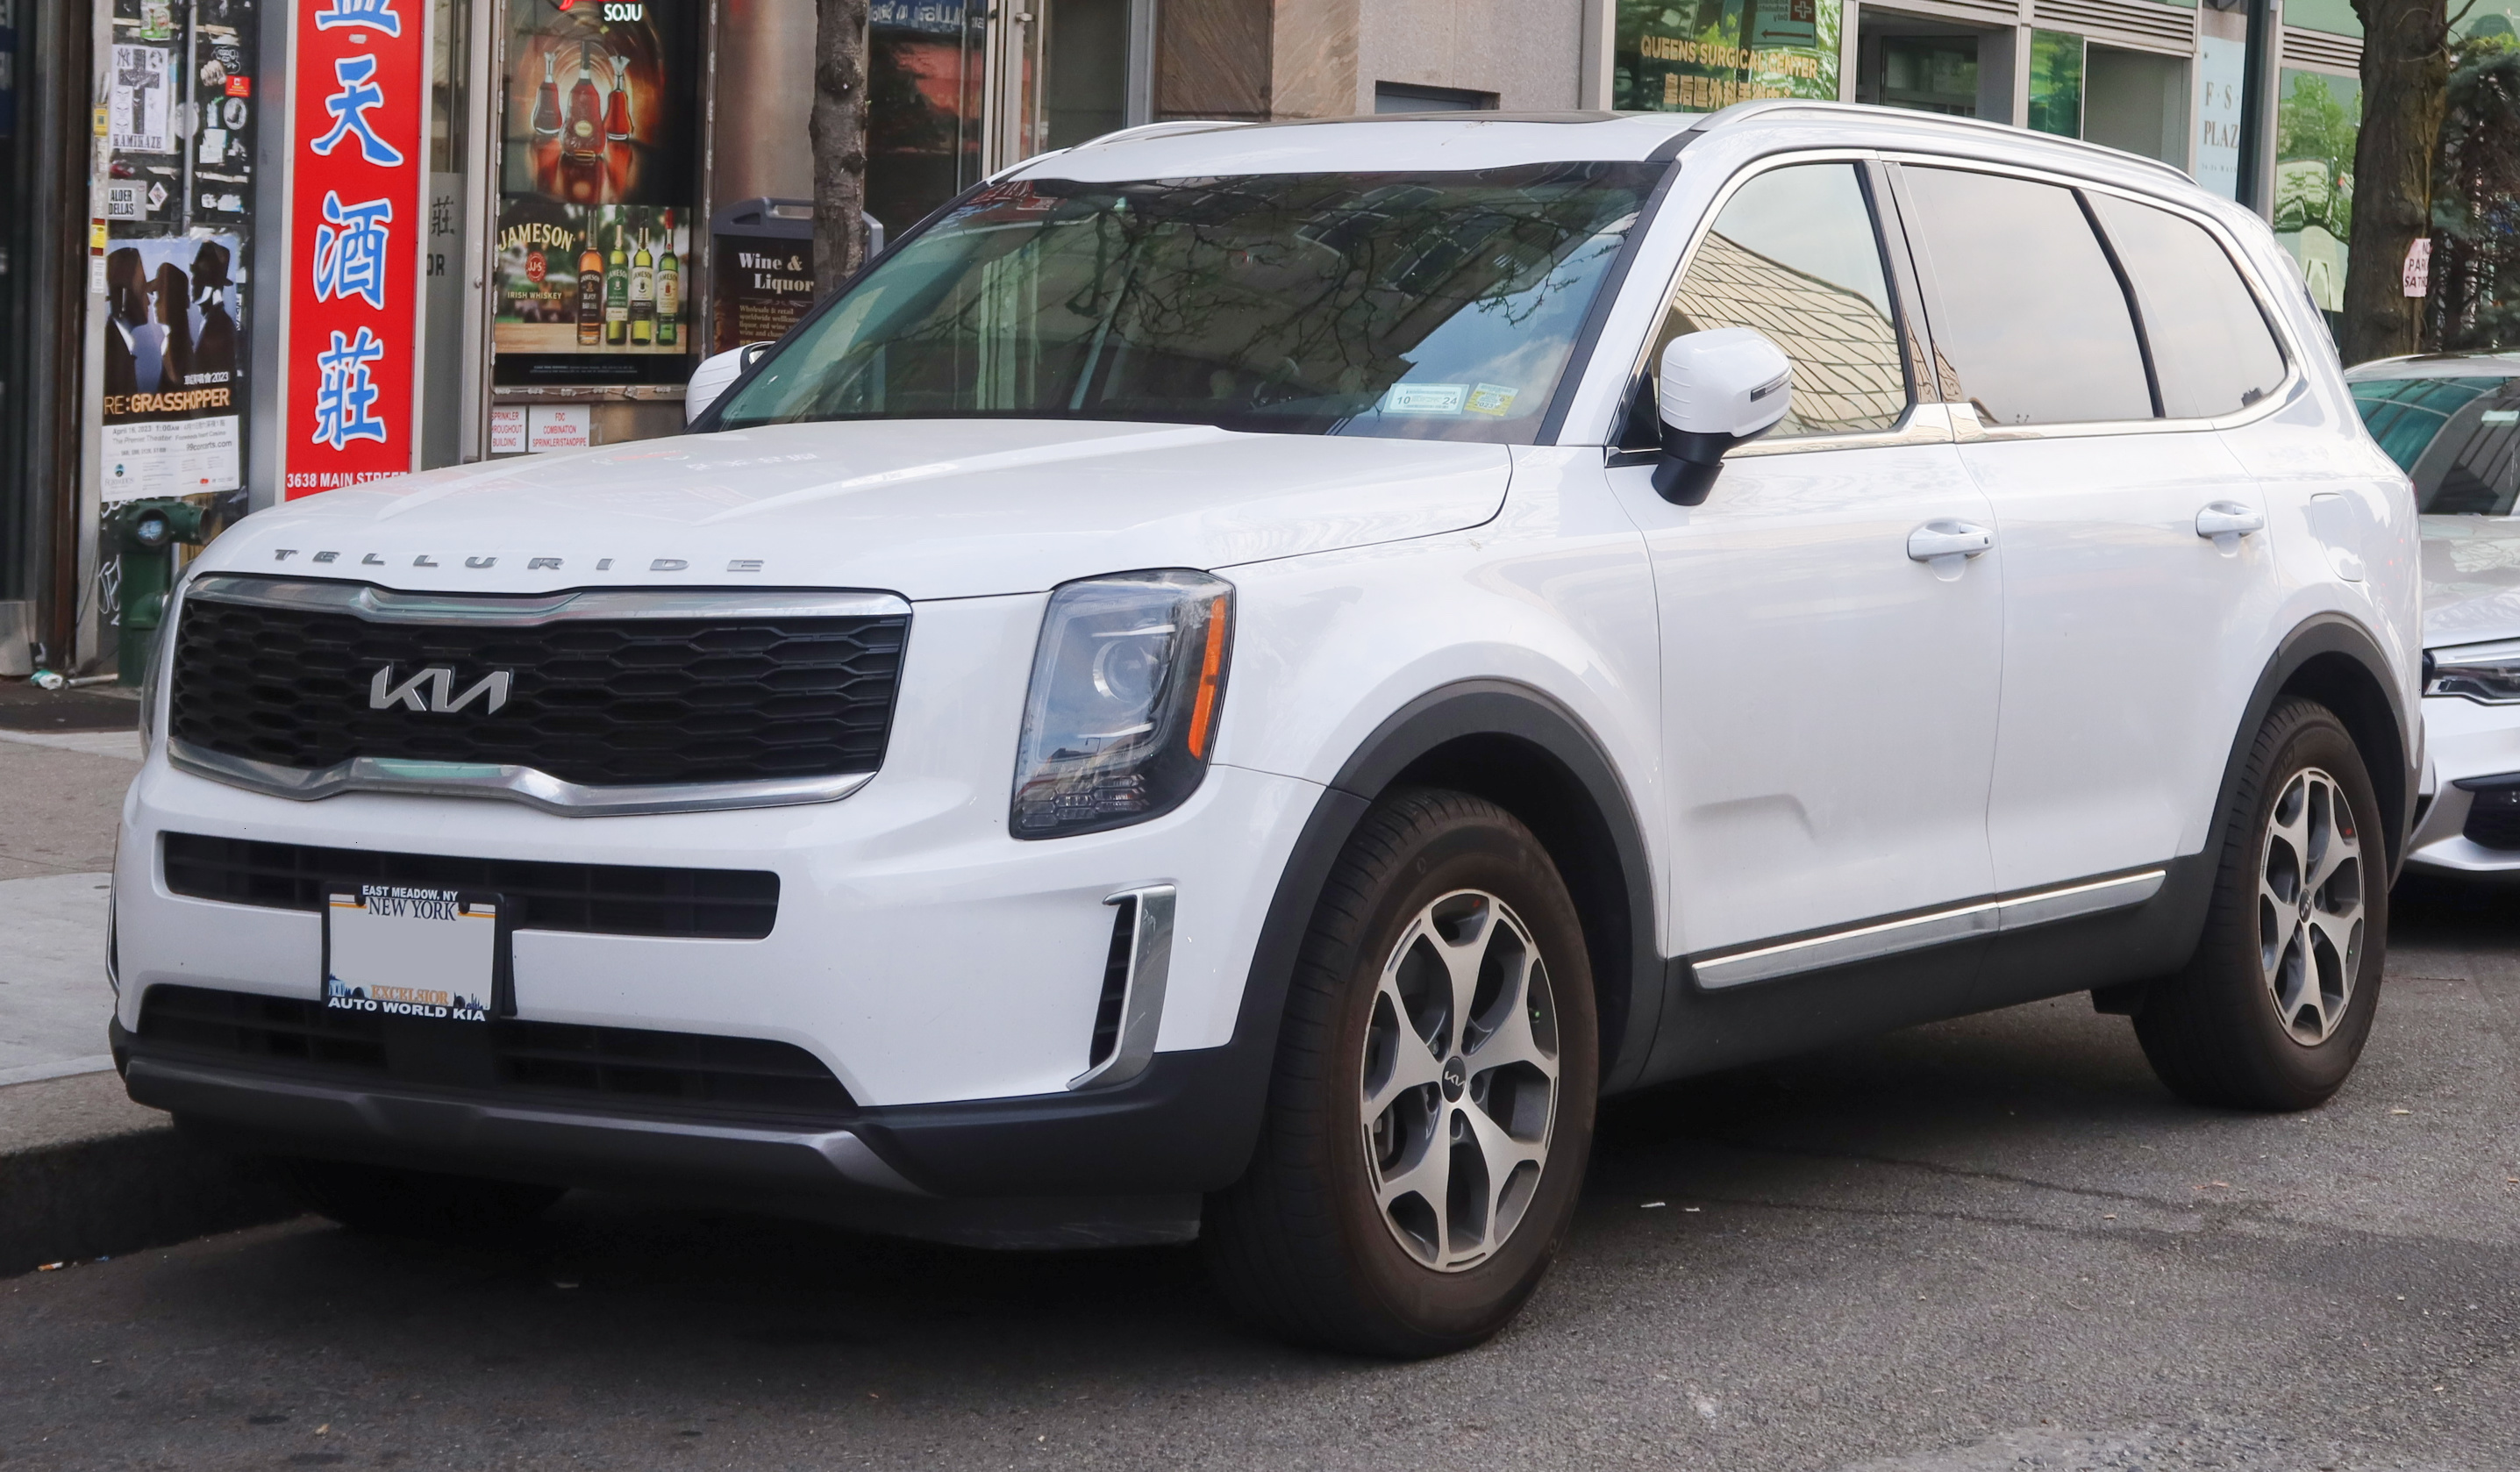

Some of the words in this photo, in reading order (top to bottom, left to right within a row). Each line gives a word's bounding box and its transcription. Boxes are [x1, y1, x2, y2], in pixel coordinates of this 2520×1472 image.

[604, 4, 642, 22] SOJU
[1641, 35, 1696, 63] QUEENS
[1700, 43, 1766, 73] SURGICAL
[1767, 53, 1817, 79] CENTER
[113, 134, 162, 149] KAMIKAZE
[2203, 120, 2239, 149] PLAZ
[497, 223, 574, 253] JAMESON
[739, 253, 782, 270] Wine
[787, 255, 803, 271] &
[581, 274, 601, 282] JAMESON
[608, 269, 627, 280] JAMESON
[754, 274, 814, 294] Liquor
[529, 291, 561, 300] WHISKEY
[1397, 396, 1411, 404] 10
[1442, 397, 1458, 405] 24
[492, 411, 519, 420] SPRINKLER
[555, 412, 566, 421] FDC
[543, 425, 576, 434] COMBINATION
[493, 438, 517, 447] BUILDING
[287, 473, 317, 488] 3638
[320, 473, 353, 488] MAIN
[275, 548, 765, 572] TELLURIDE
[369, 665, 513, 715] KIA
[362, 885, 389, 897] EAST
[443, 890, 458, 902] NY
[368, 897, 409, 918] NEW
[410, 898, 457, 921] YORK
[371, 984, 449, 1005] EXCELSIOR
[328, 997, 376, 1011] AUTO
[382, 1001, 447, 1018] WORLD
[453, 1008, 485, 1021] KIA
